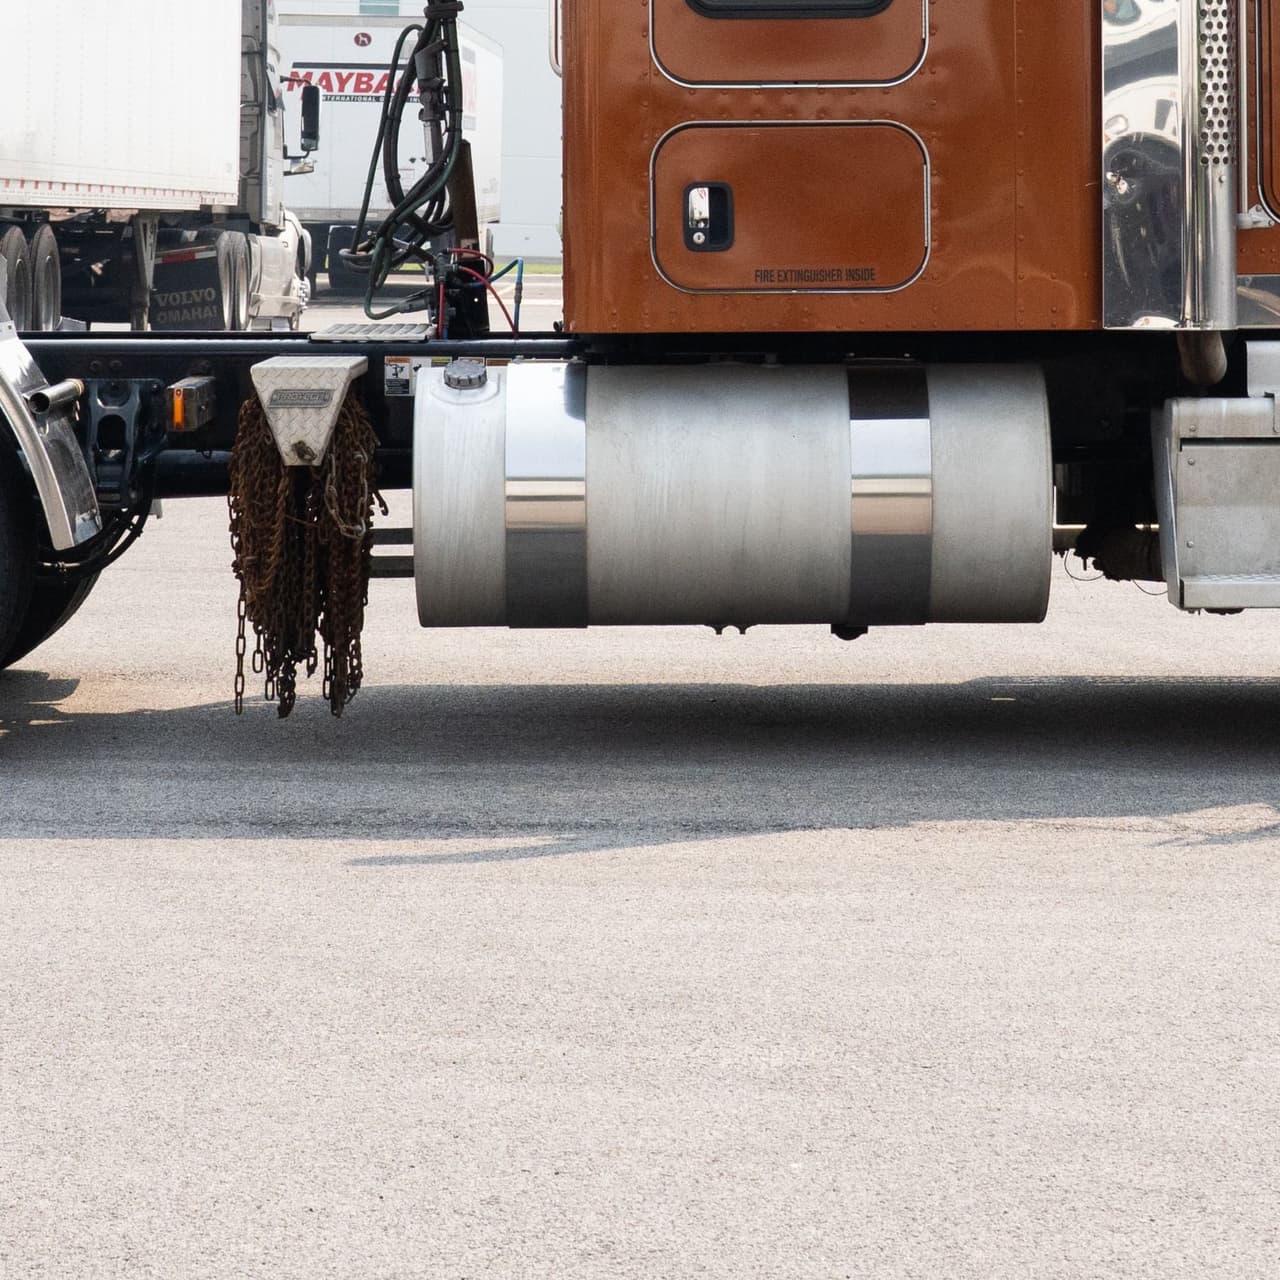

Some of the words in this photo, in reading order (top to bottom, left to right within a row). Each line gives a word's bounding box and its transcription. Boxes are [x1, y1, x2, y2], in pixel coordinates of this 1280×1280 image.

[754, 269, 776, 282] FIRE
[777, 269, 843, 282] EXTINGUISHER
[845, 267, 876, 281] INSIDE
[154, 287, 217, 307] VOLVO
